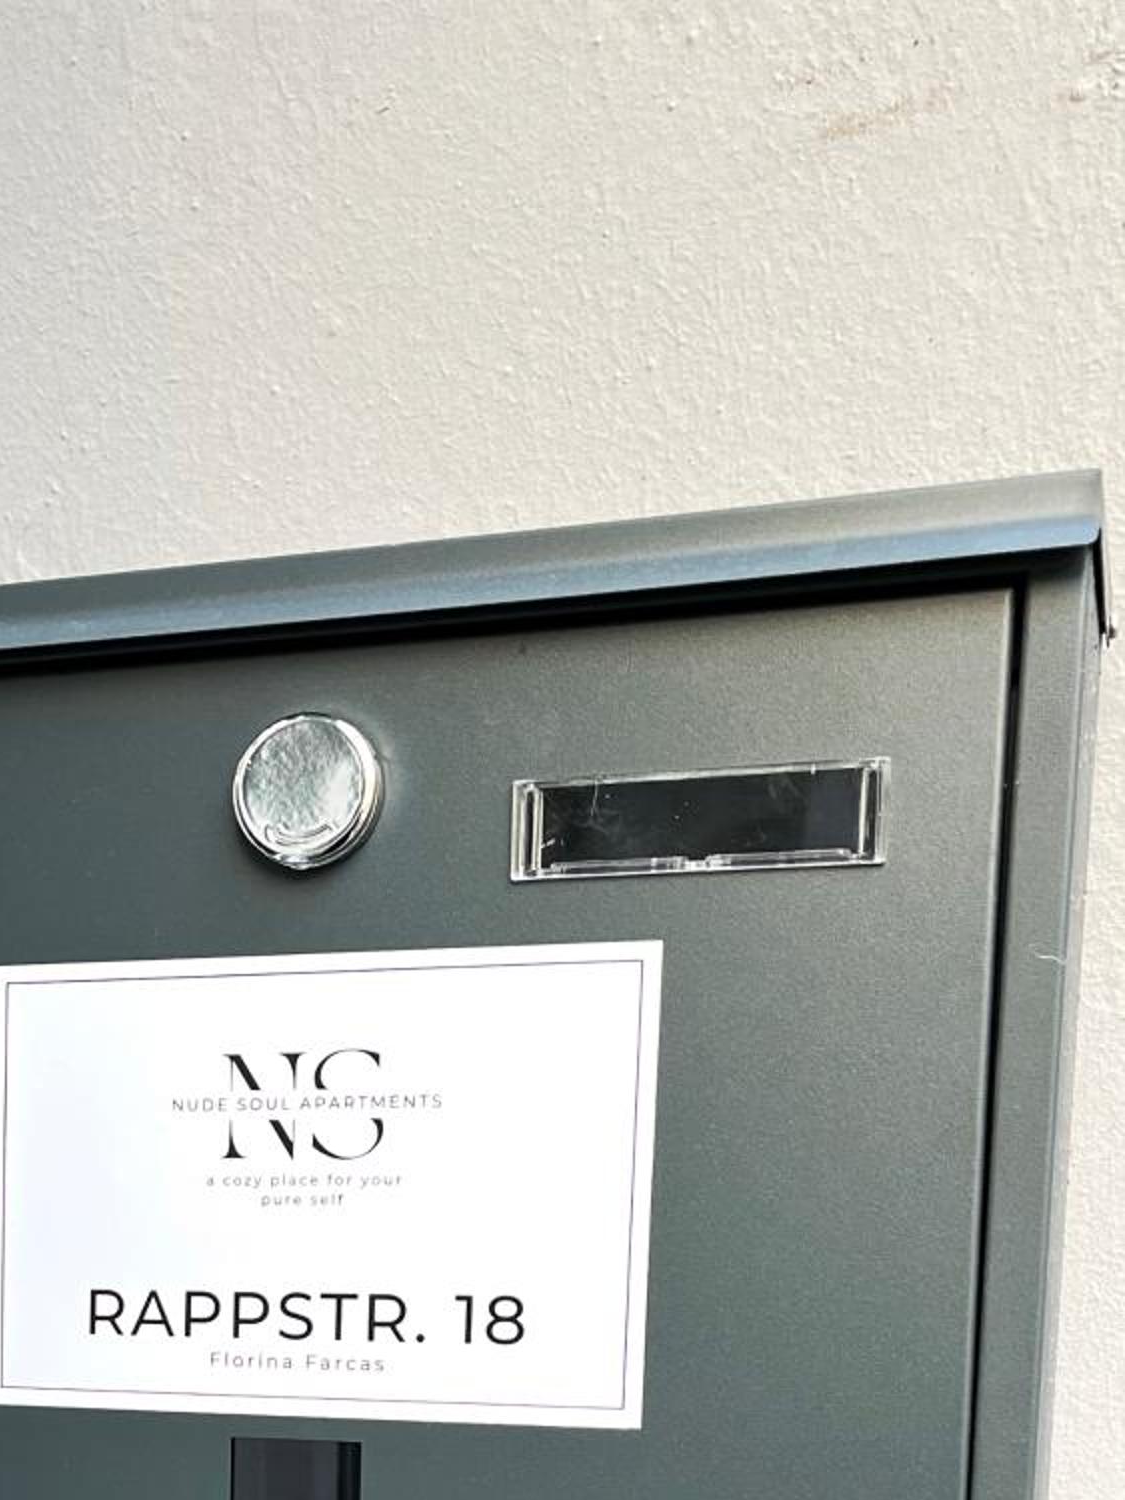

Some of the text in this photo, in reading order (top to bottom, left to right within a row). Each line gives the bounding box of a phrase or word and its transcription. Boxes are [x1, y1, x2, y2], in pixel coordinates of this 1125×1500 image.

[171, 1093, 443, 1113] NUDE SOUL APARTMENTS
[206, 1173, 403, 1190] a cozy place for your
[261, 1192, 345, 1208] pure self
[87, 1288, 525, 1345] RAPPSTR. 18
[209, 1351, 386, 1372] Florina Farcas
